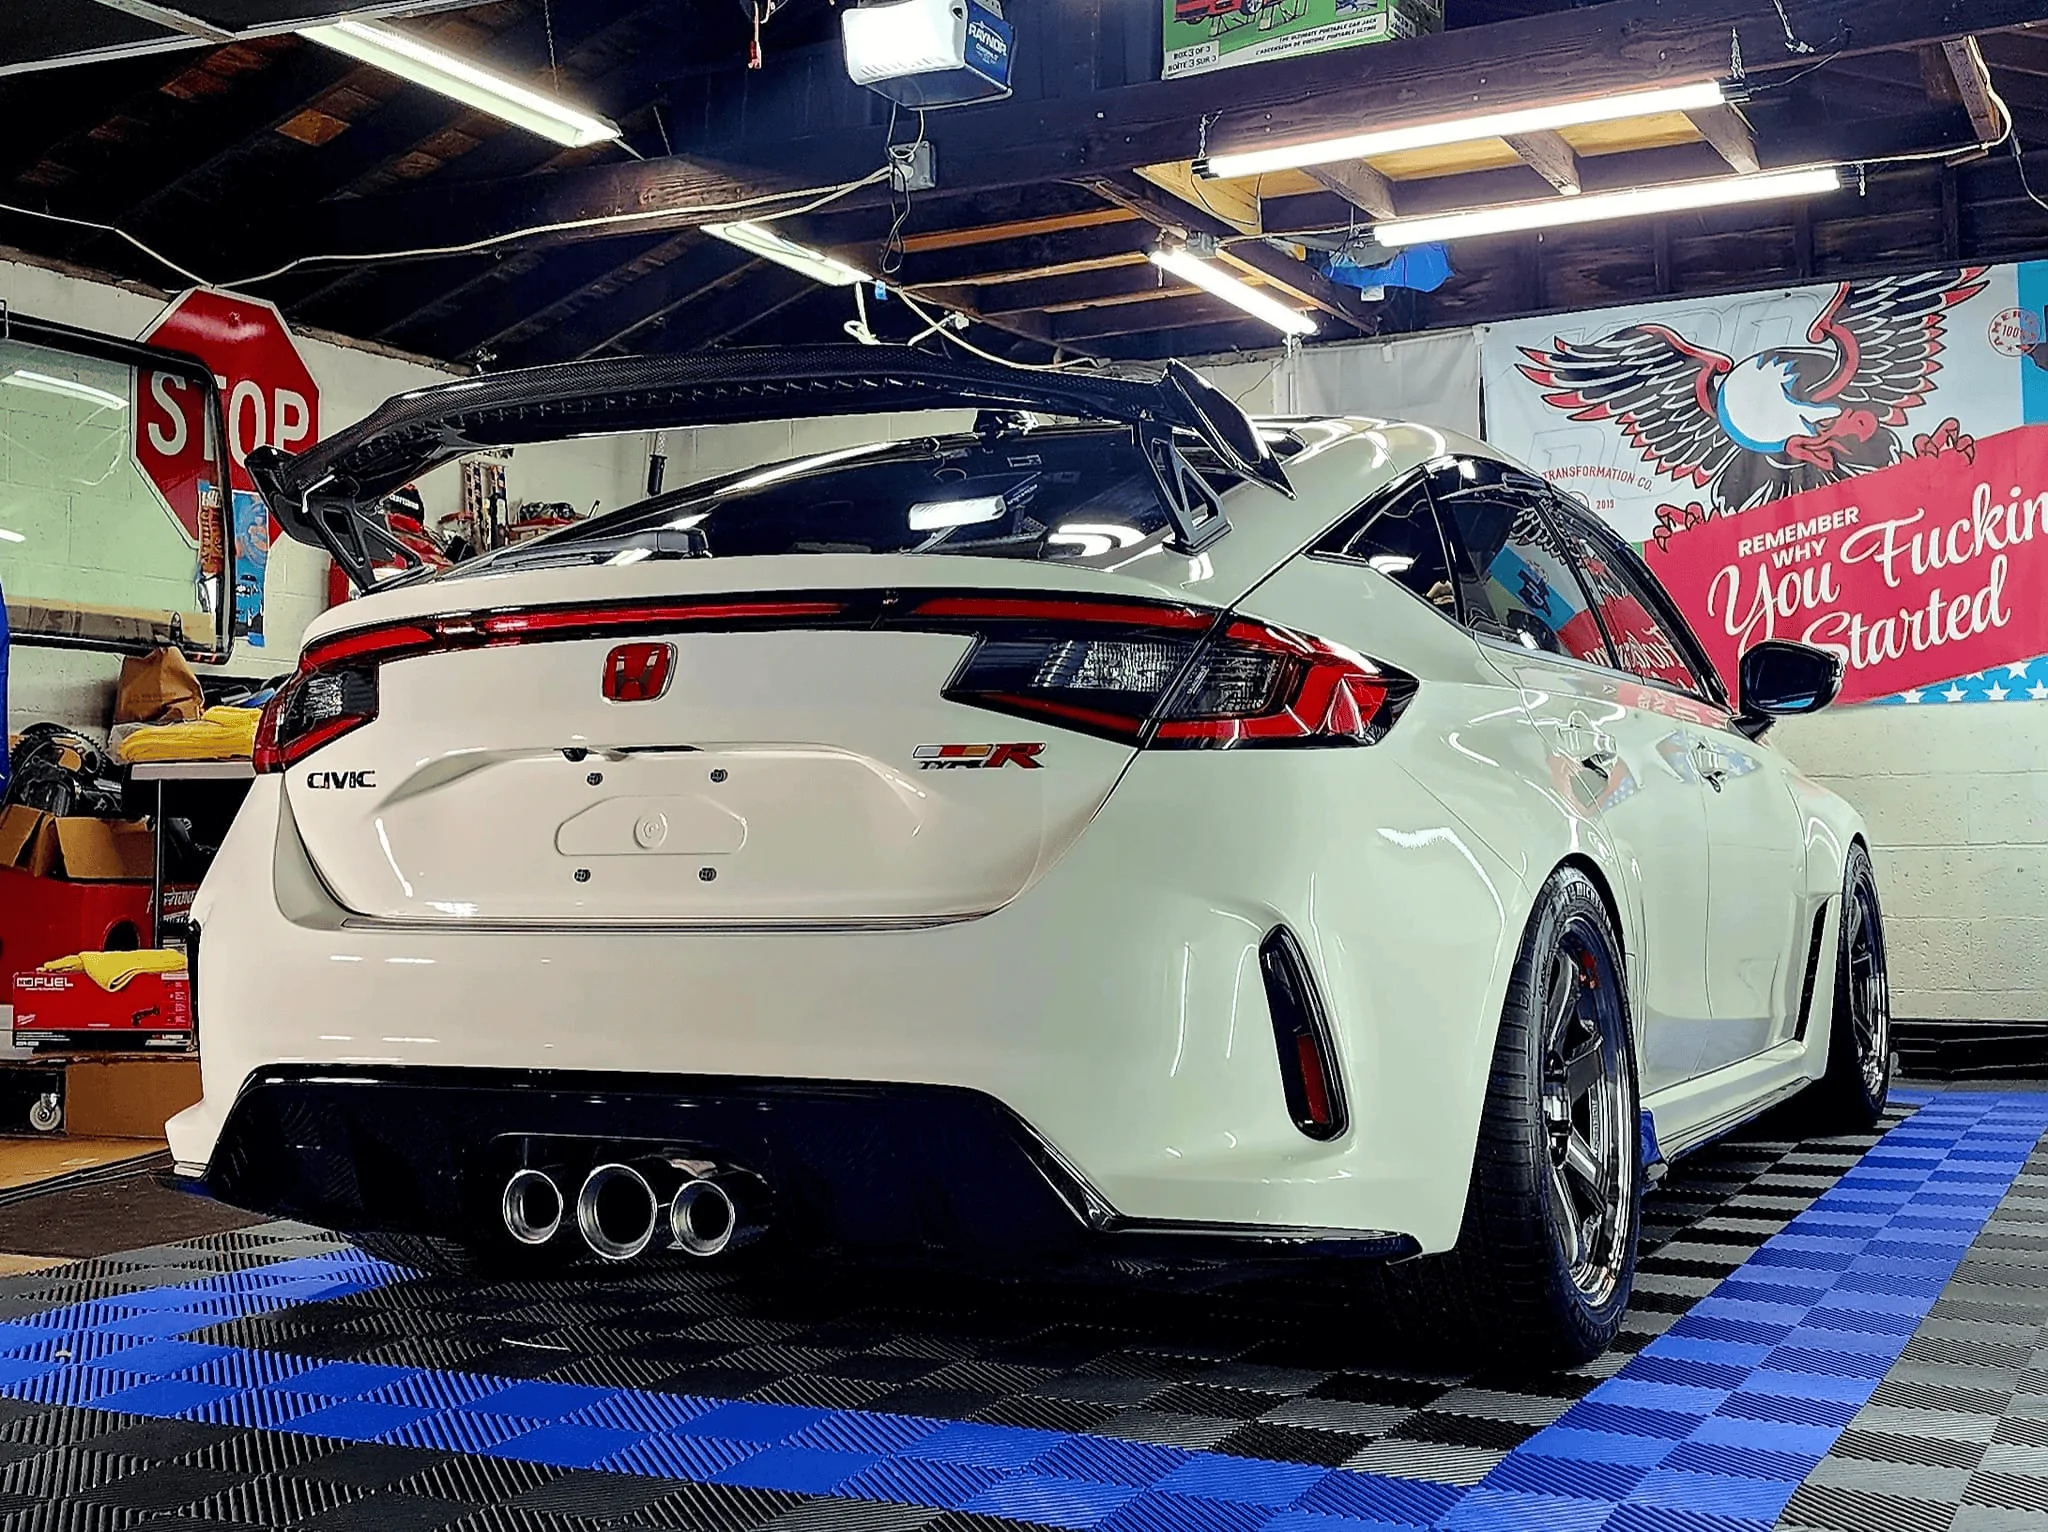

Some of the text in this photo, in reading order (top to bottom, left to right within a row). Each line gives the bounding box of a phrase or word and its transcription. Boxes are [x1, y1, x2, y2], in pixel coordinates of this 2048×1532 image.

[969, 22, 1007, 56] RAYNOR
[1173, 45, 1211, 60] BOX 3 OF 3
[1189, 57, 1195, 67] 3
[1195, 56, 1210, 66] SUR
[1211, 55, 1217, 63] 3
[148, 371, 309, 468] STOP
[1541, 465, 1653, 492] TRANSFORMATION CO.
[1596, 499, 1615, 510] 2019
[1738, 506, 1860, 557] REMEMBER
[1771, 538, 1827, 569] WHY
[1707, 560, 1841, 658] You
[1802, 554, 2012, 670] Started
[982, 743, 1046, 769] R
[307, 770, 376, 789] CIVIC
[34, 977, 74, 987] FUEL
